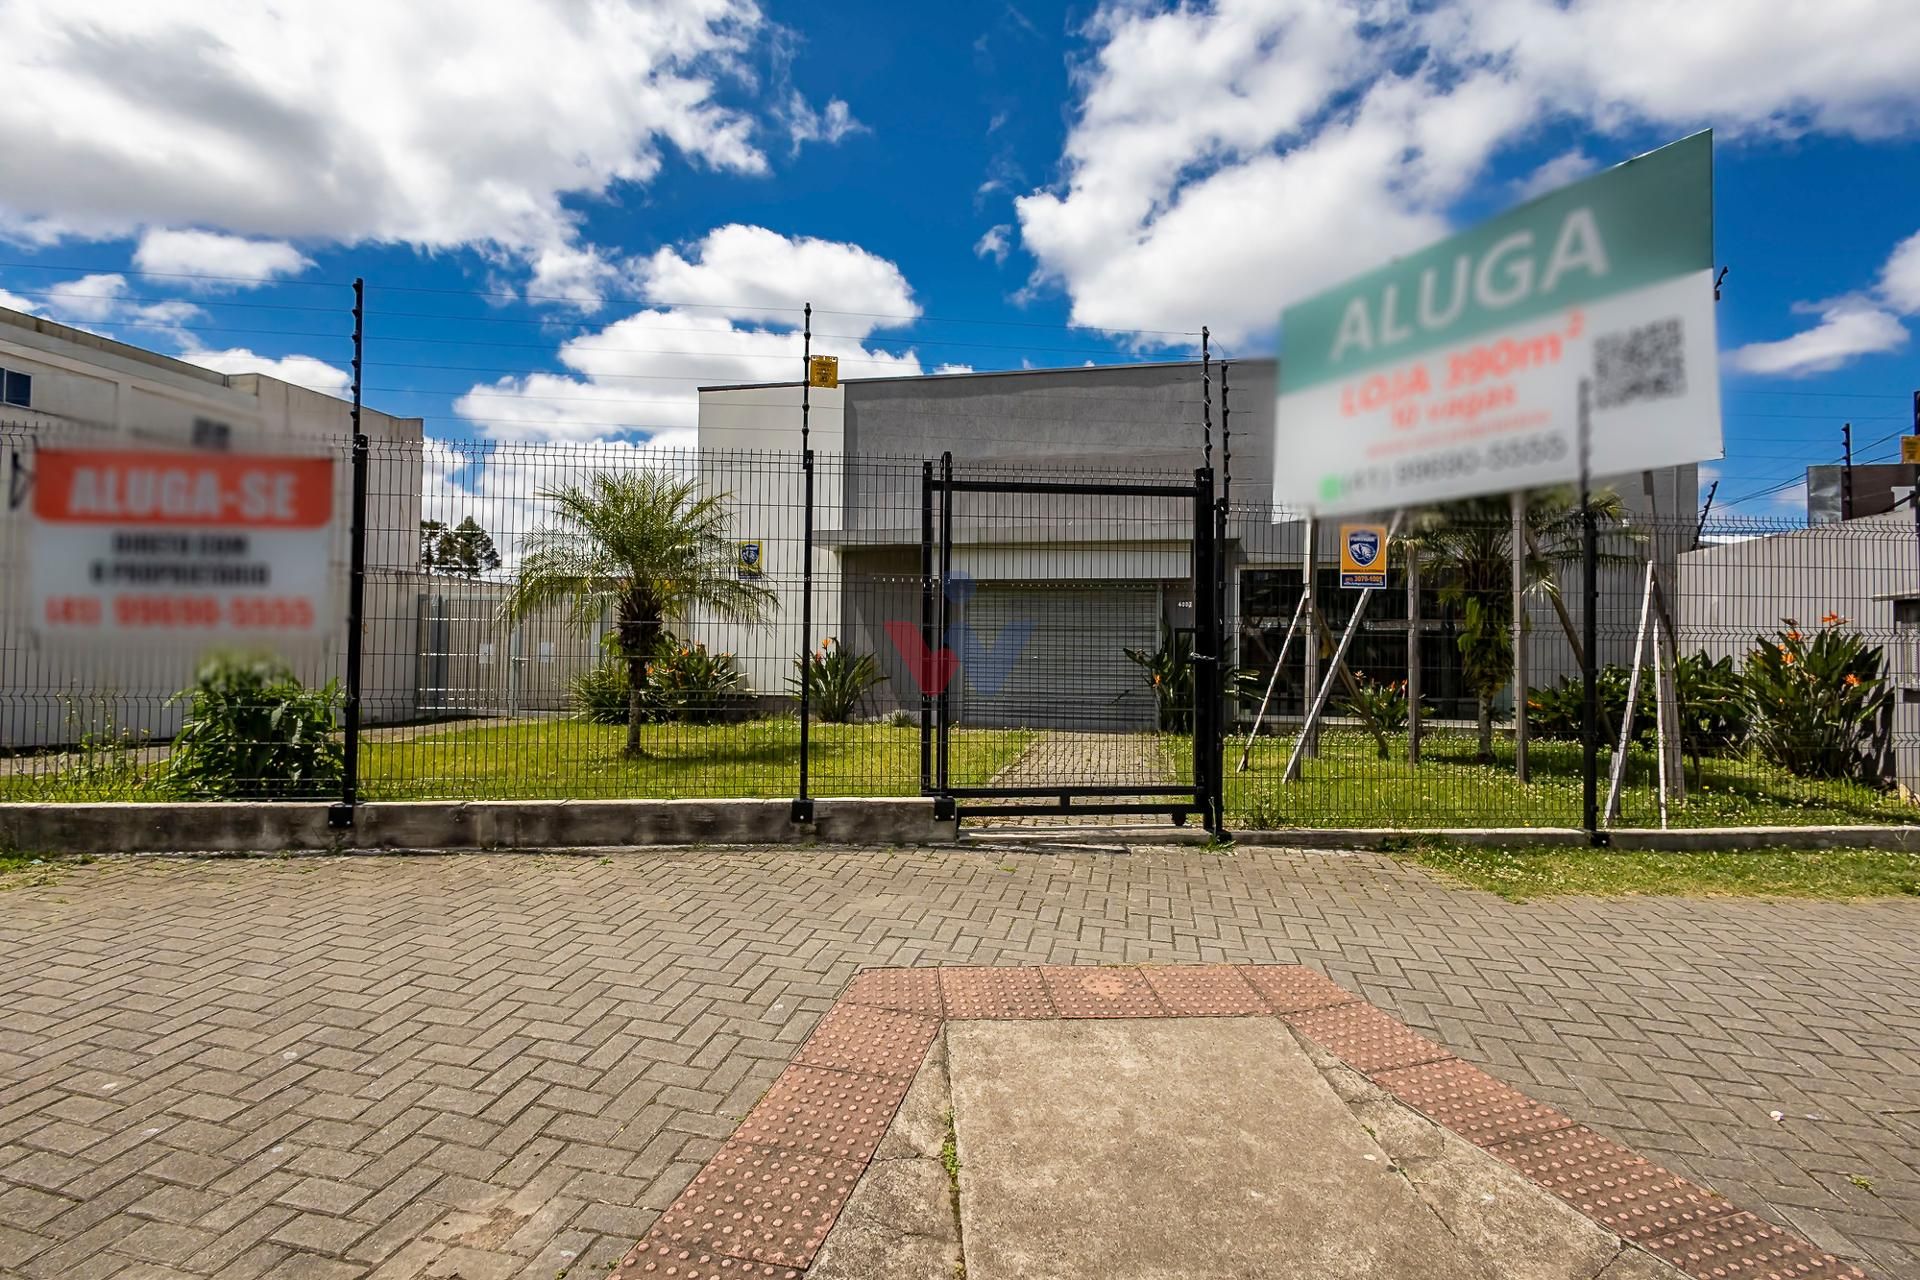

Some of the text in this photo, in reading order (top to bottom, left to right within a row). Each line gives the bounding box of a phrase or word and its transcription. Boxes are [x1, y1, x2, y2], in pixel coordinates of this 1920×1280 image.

[1329, 207, 1609, 361] ALUGA
[1340, 363, 1431, 418] LOJA
[67, 467, 298, 519] ALUGA-SE
